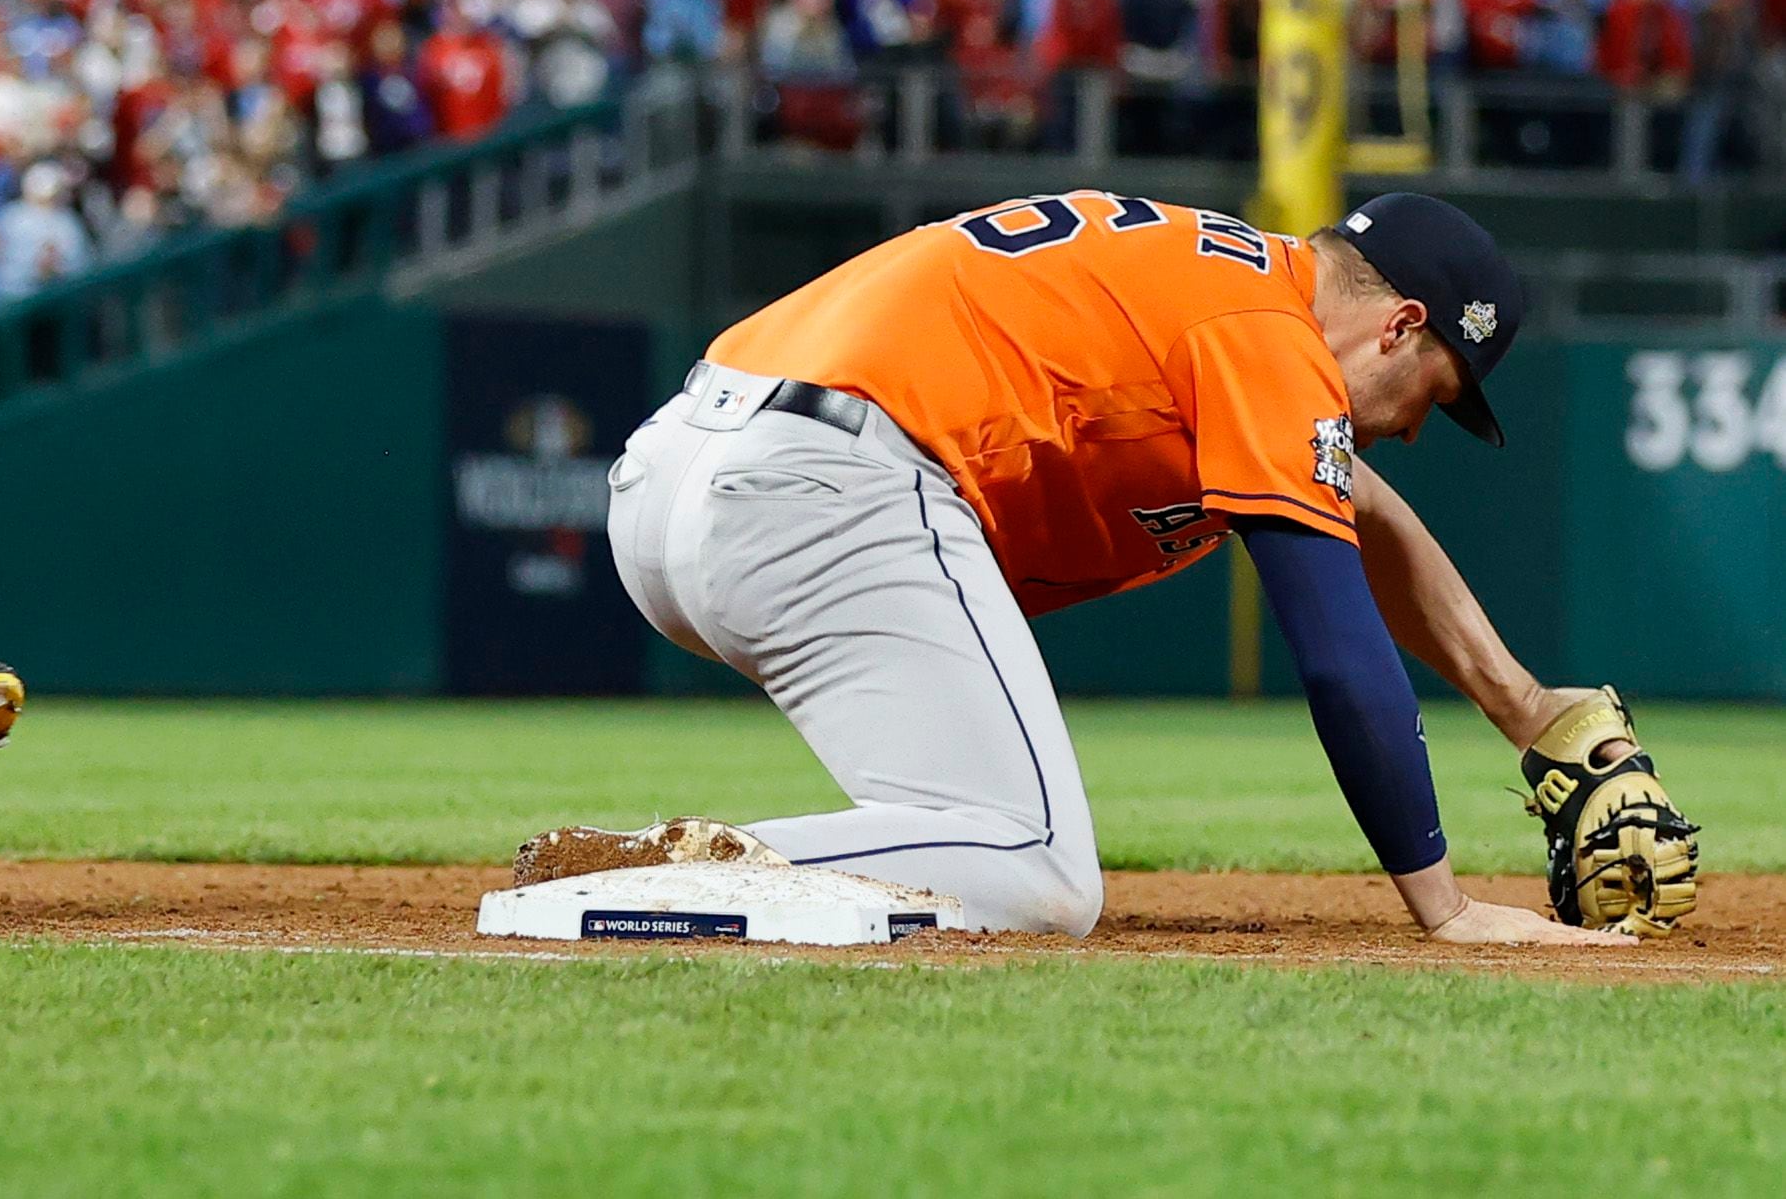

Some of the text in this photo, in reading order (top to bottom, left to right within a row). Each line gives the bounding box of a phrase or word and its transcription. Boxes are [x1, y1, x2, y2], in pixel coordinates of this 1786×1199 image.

[1315, 418, 1354, 455] WOR
[606, 919, 651, 932] WORLD
[651, 921, 691, 934] SERIES
